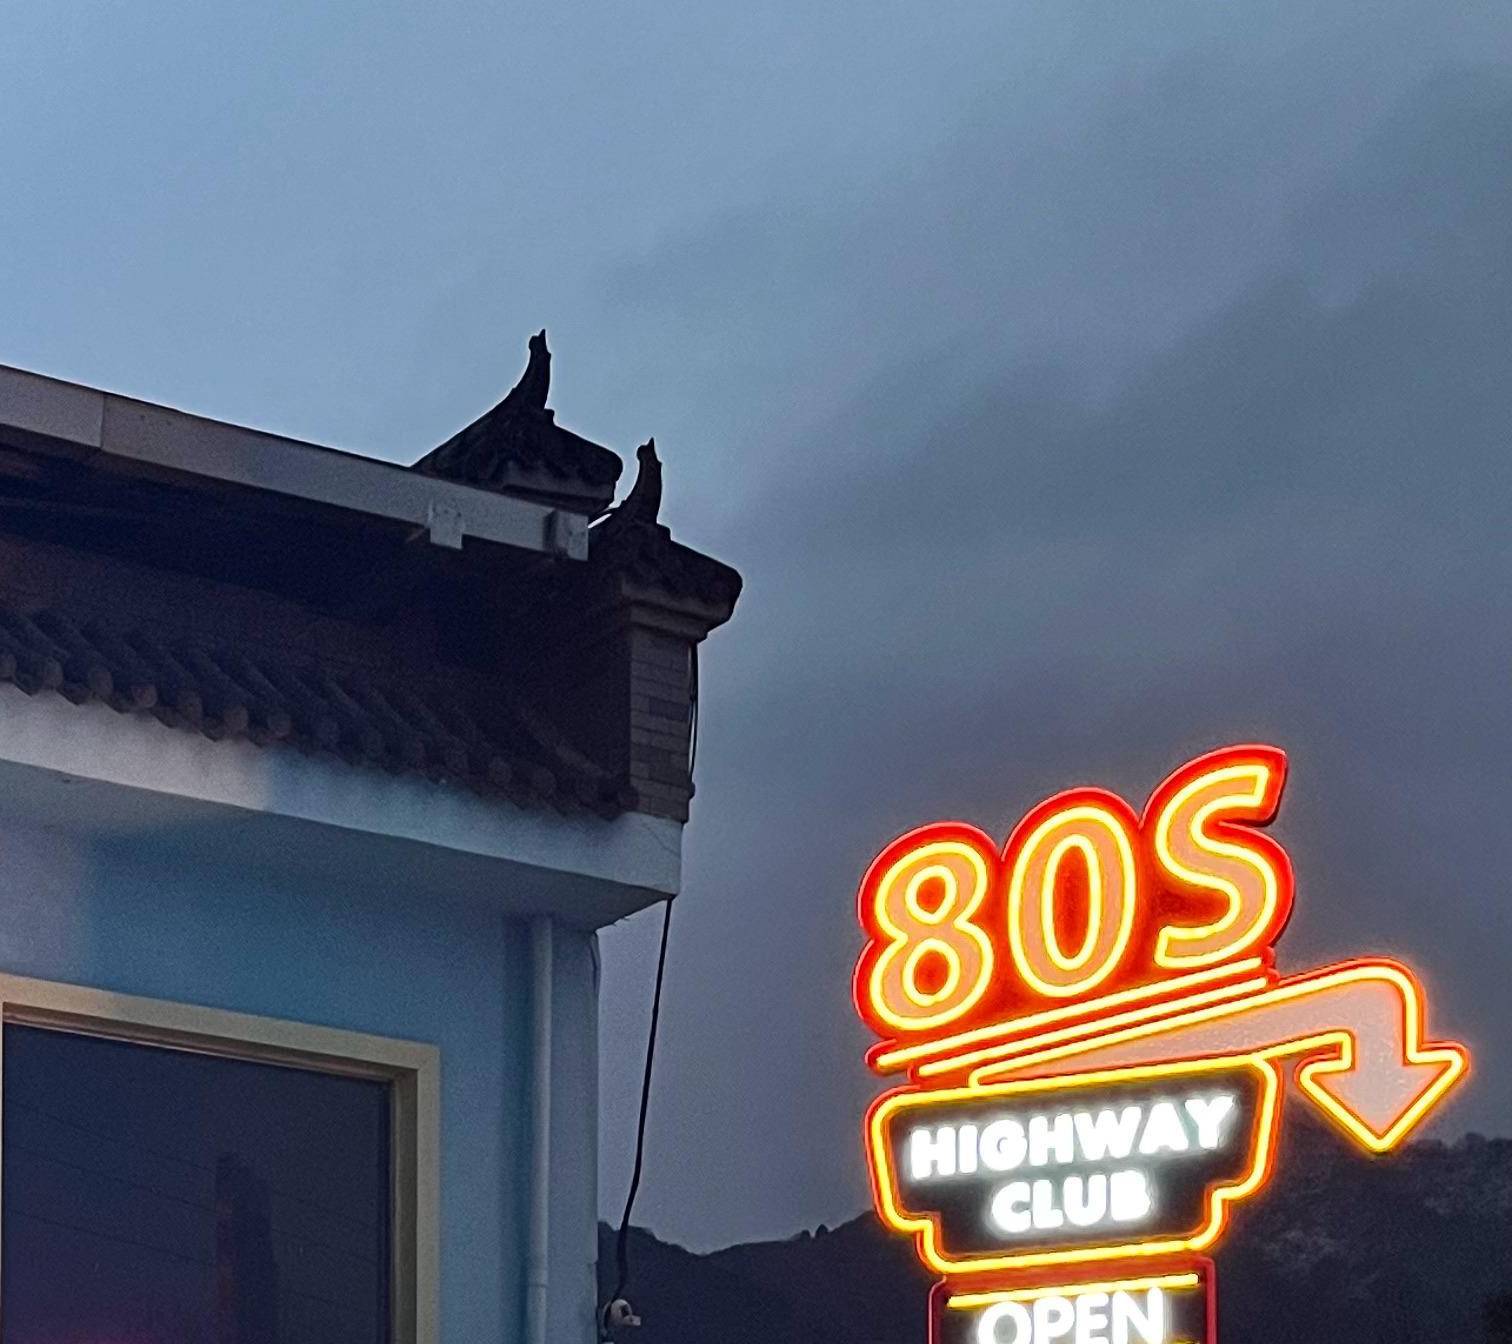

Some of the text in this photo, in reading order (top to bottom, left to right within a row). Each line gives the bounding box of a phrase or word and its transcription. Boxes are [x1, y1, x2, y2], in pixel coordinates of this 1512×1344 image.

[869, 761, 1279, 1033] 80S
[908, 1093, 1236, 1181] HIGHWAY
[989, 1169, 1153, 1236] CLUB
